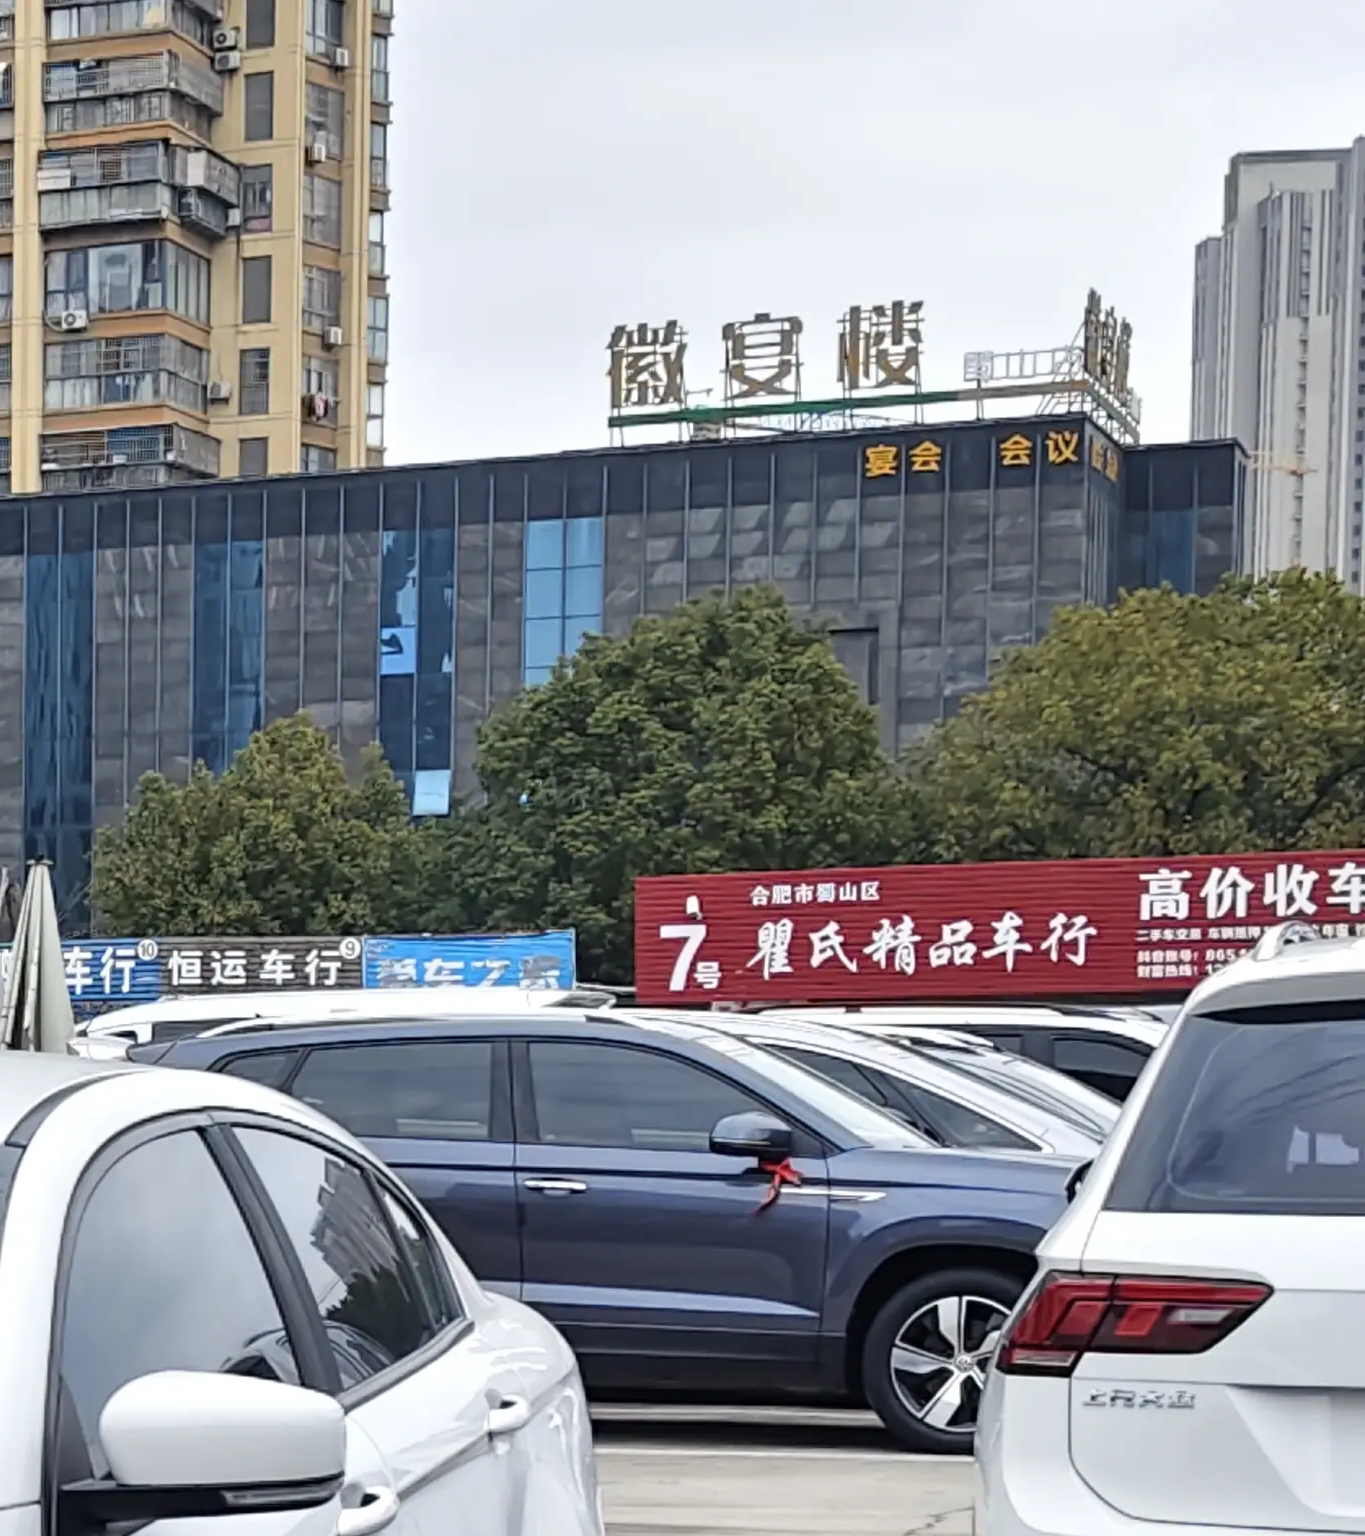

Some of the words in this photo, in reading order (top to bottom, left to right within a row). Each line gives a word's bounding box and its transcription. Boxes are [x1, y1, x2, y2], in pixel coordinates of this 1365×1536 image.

[864, 439, 942, 478] 宴会
[999, 430, 1079, 467] 会议
[750, 881, 881, 906] 合肥市蜀山区
[1138, 862, 1365, 920] 高价收车
[63, 946, 136, 994] 车行
[139, 940, 156, 958] 10
[169, 949, 342, 986] 恒运车行
[343, 939, 357, 958] 9
[659, 924, 722, 992] 7号
[745, 911, 1098, 980] 瞿氏精品车行
